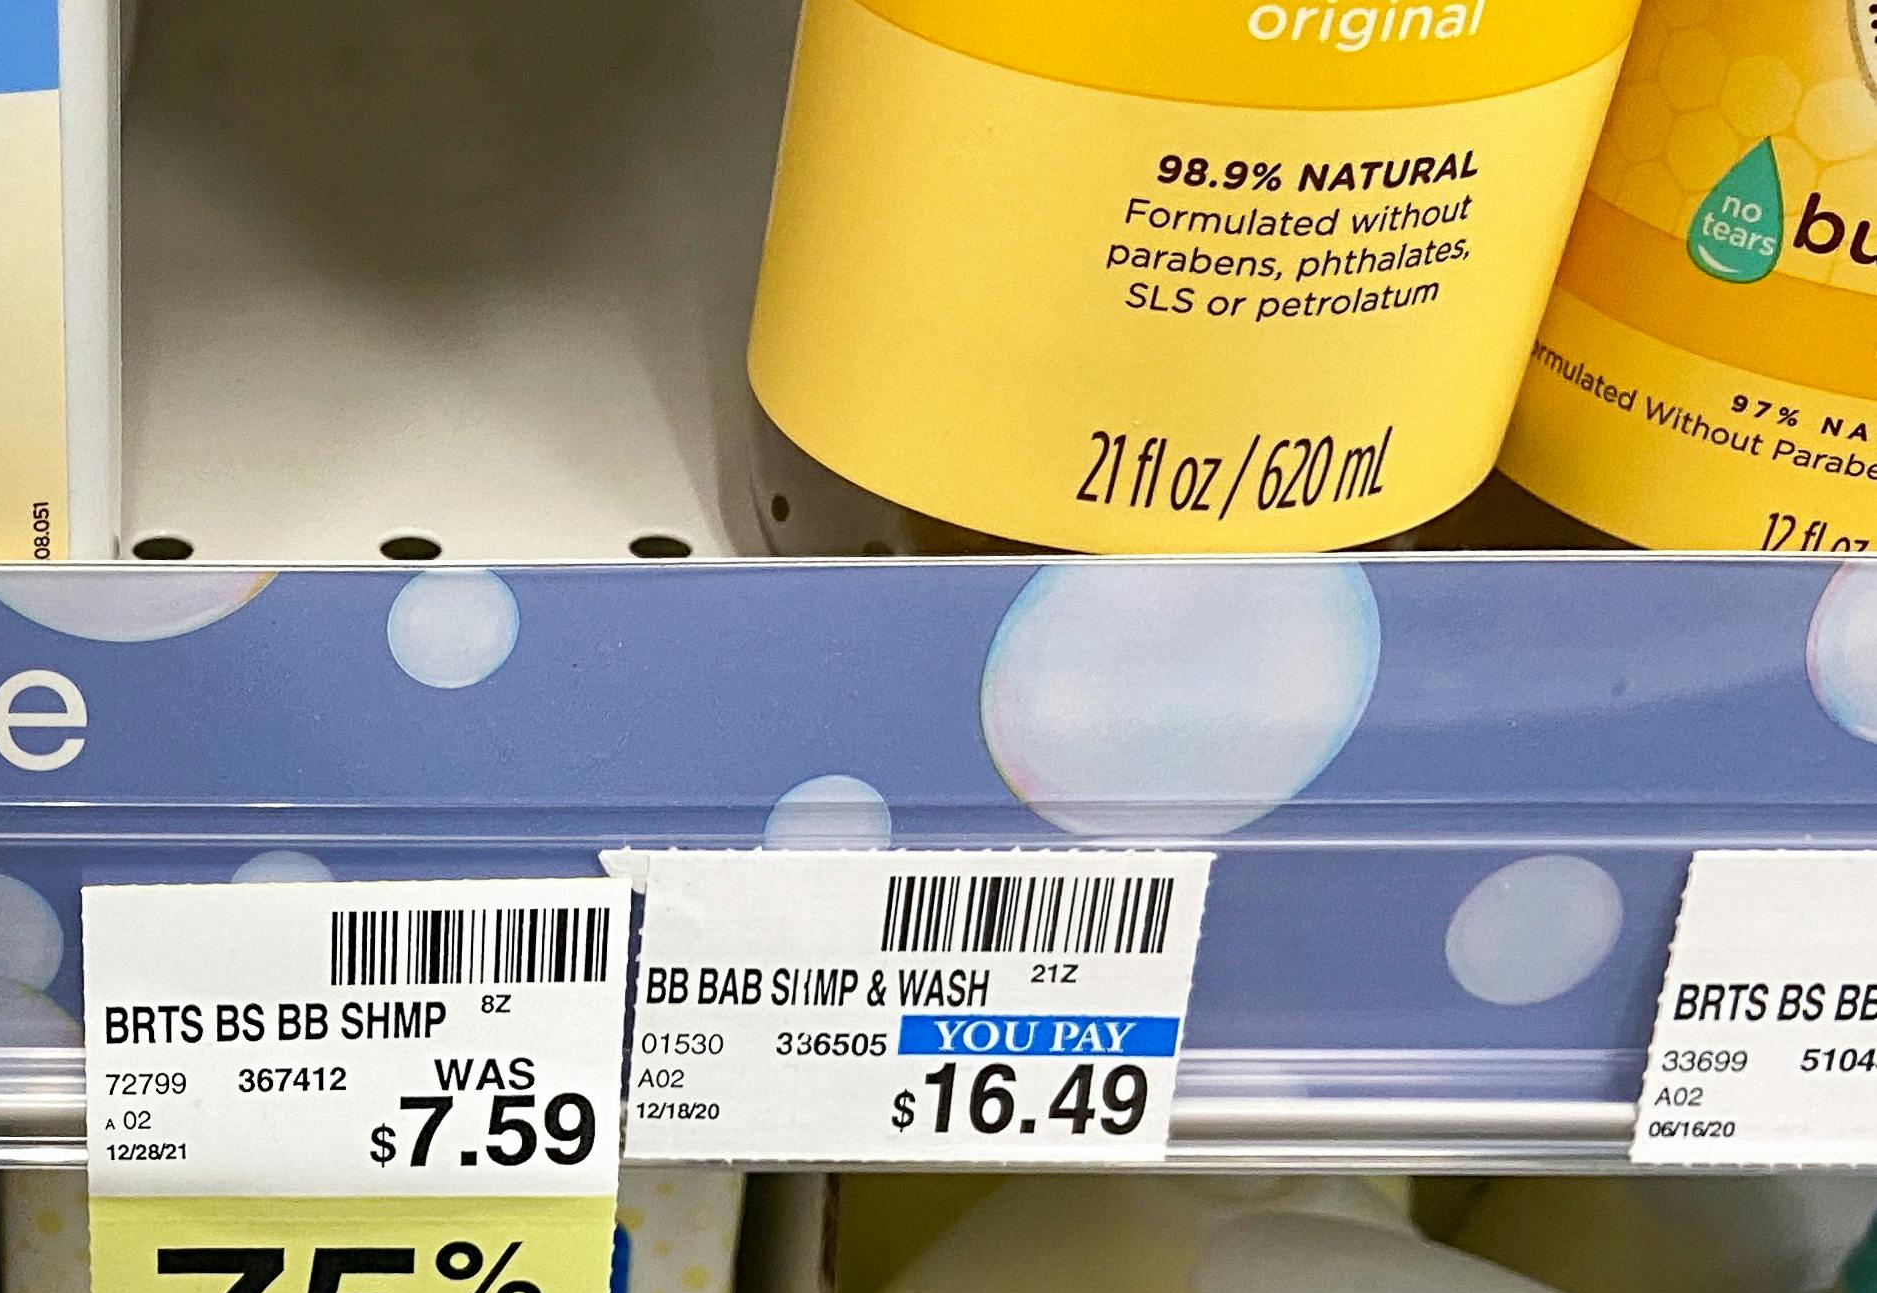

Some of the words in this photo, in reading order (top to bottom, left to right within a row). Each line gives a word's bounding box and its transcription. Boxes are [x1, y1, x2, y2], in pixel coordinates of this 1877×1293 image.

[1247, 0, 1485, 52] original
[1157, 154, 1282, 191] 98.9%
[1298, 150, 1479, 192] NATURAL
[1125, 198, 1340, 236] Formulated
[1351, 195, 1473, 234] without
[1722, 195, 1762, 223] no
[1702, 211, 1778, 257] tears
[1106, 243, 1283, 281] parabens,
[1296, 238, 1470, 282] phthalates,
[1125, 282, 1194, 314] SLS
[1207, 294, 1247, 317] or
[1255, 281, 1439, 322] petrolatum
[1646, 395, 1763, 456] Without
[1730, 394, 1803, 428] 97%
[1076, 430, 1127, 504] 21
[1130, 437, 1167, 508] fl
[1170, 456, 1222, 512] oz
[1217, 433, 1261, 521] /
[1257, 434, 1335, 511] 620
[647, 967, 689, 1005] BB
[698, 967, 762, 1005] BAB
[866, 969, 888, 1007] &
[899, 968, 990, 1007] WASH
[1031, 964, 1078, 984] 21Z
[1673, 983, 1769, 1021] BRTS
[1777, 983, 1826, 1021] BS
[106, 1004, 203, 1044] BRTS
[216, 1003, 265, 1042] BS
[278, 1002, 328, 1041] BB
[341, 1000, 447, 1040] SHMP
[481, 994, 511, 1014] 8Z
[933, 1020, 1036, 1052] YOU
[1048, 1021, 1137, 1053] PAY
[641, 1033, 724, 1055] 01530
[775, 1032, 887, 1056] 336505
[1661, 1050, 1748, 1072] 33699
[1800, 1048, 1877, 1072] 5104
[105, 1072, 187, 1095] 72799
[238, 1066, 347, 1093] 367412
[434, 1058, 535, 1091] WAS
[637, 1069, 684, 1088] A02
[636, 1102, 720, 1121] 12/18/20
[892, 1062, 1149, 1135] $16.49
[1654, 1087, 1703, 1106] A02
[370, 1092, 596, 1168] $7.59
[1648, 1121, 1736, 1137] 06/16/20
[106, 1143, 186, 1160] 12/28/21
